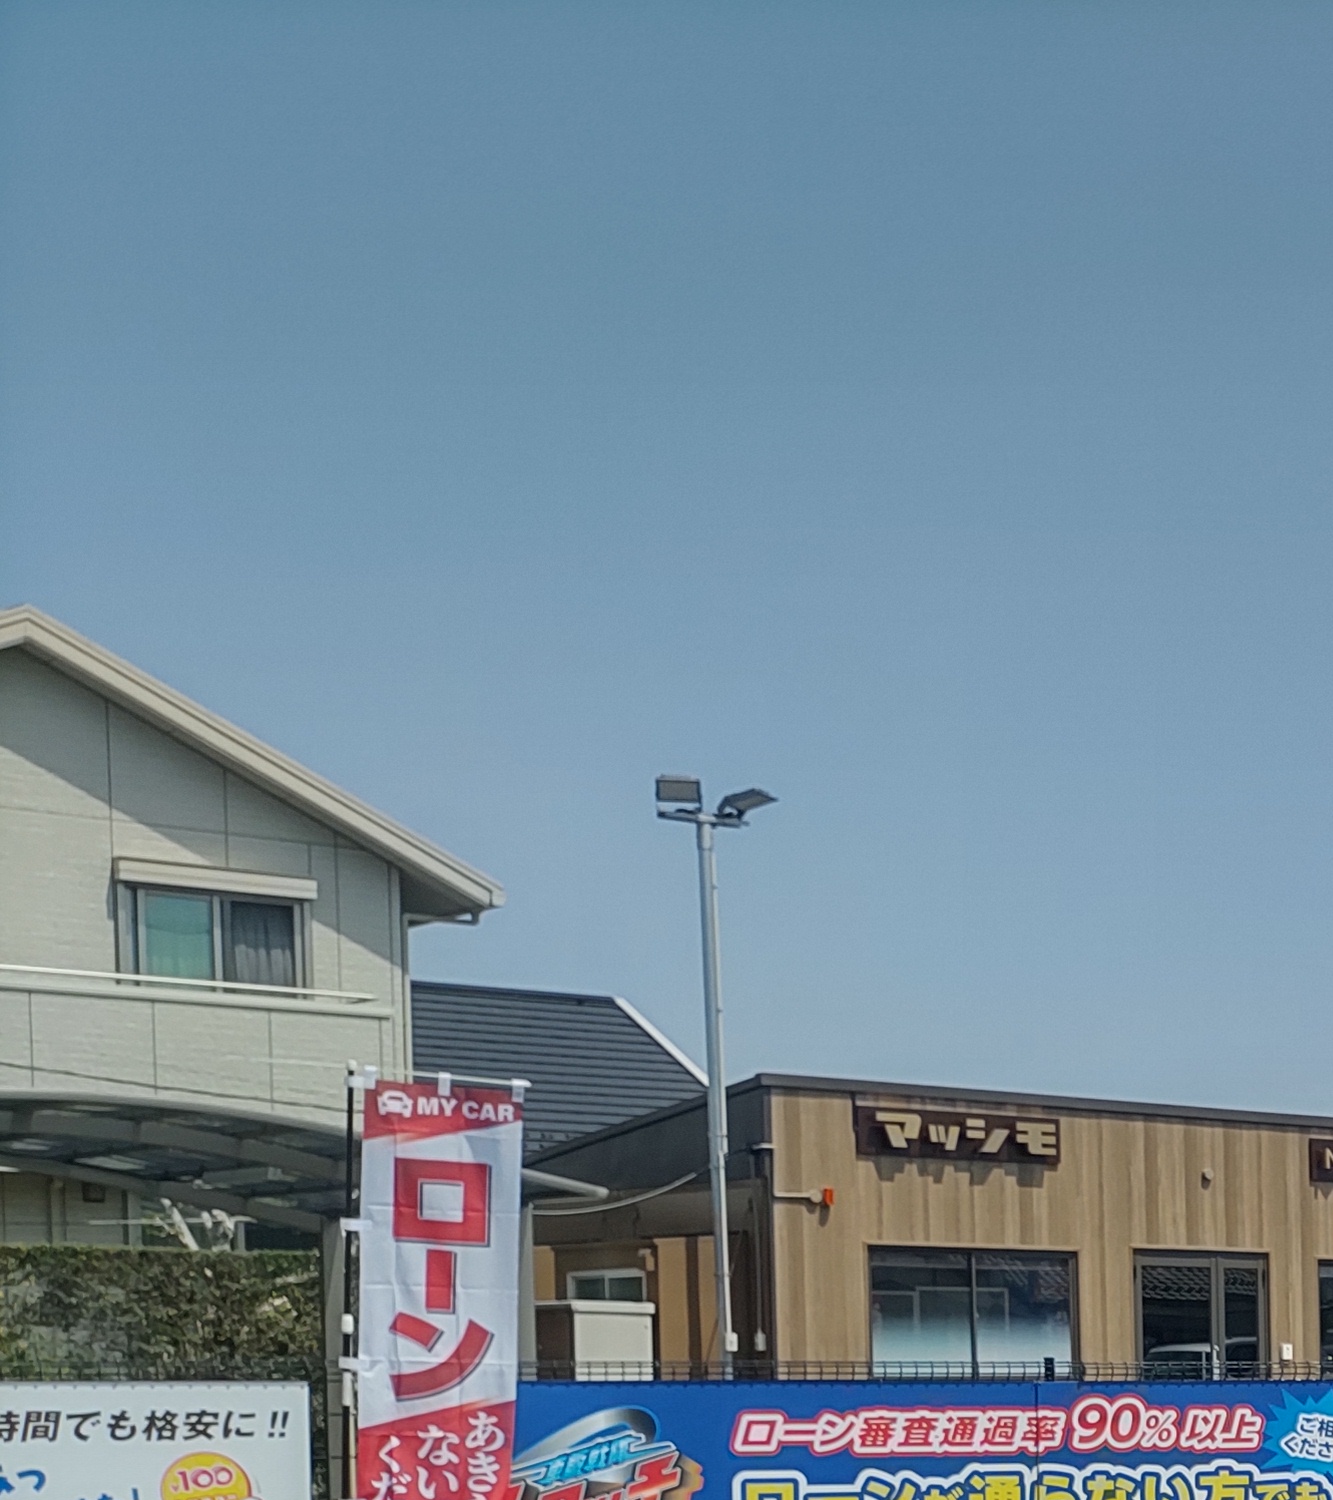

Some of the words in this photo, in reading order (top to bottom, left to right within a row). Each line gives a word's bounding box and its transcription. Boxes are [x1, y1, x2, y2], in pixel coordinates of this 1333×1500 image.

[417, 1096, 458, 1117] MY
[461, 1100, 516, 1121] CAR
[874, 1111, 1060, 1156] マッシモ
[388, 1157, 494, 1400] ローン
